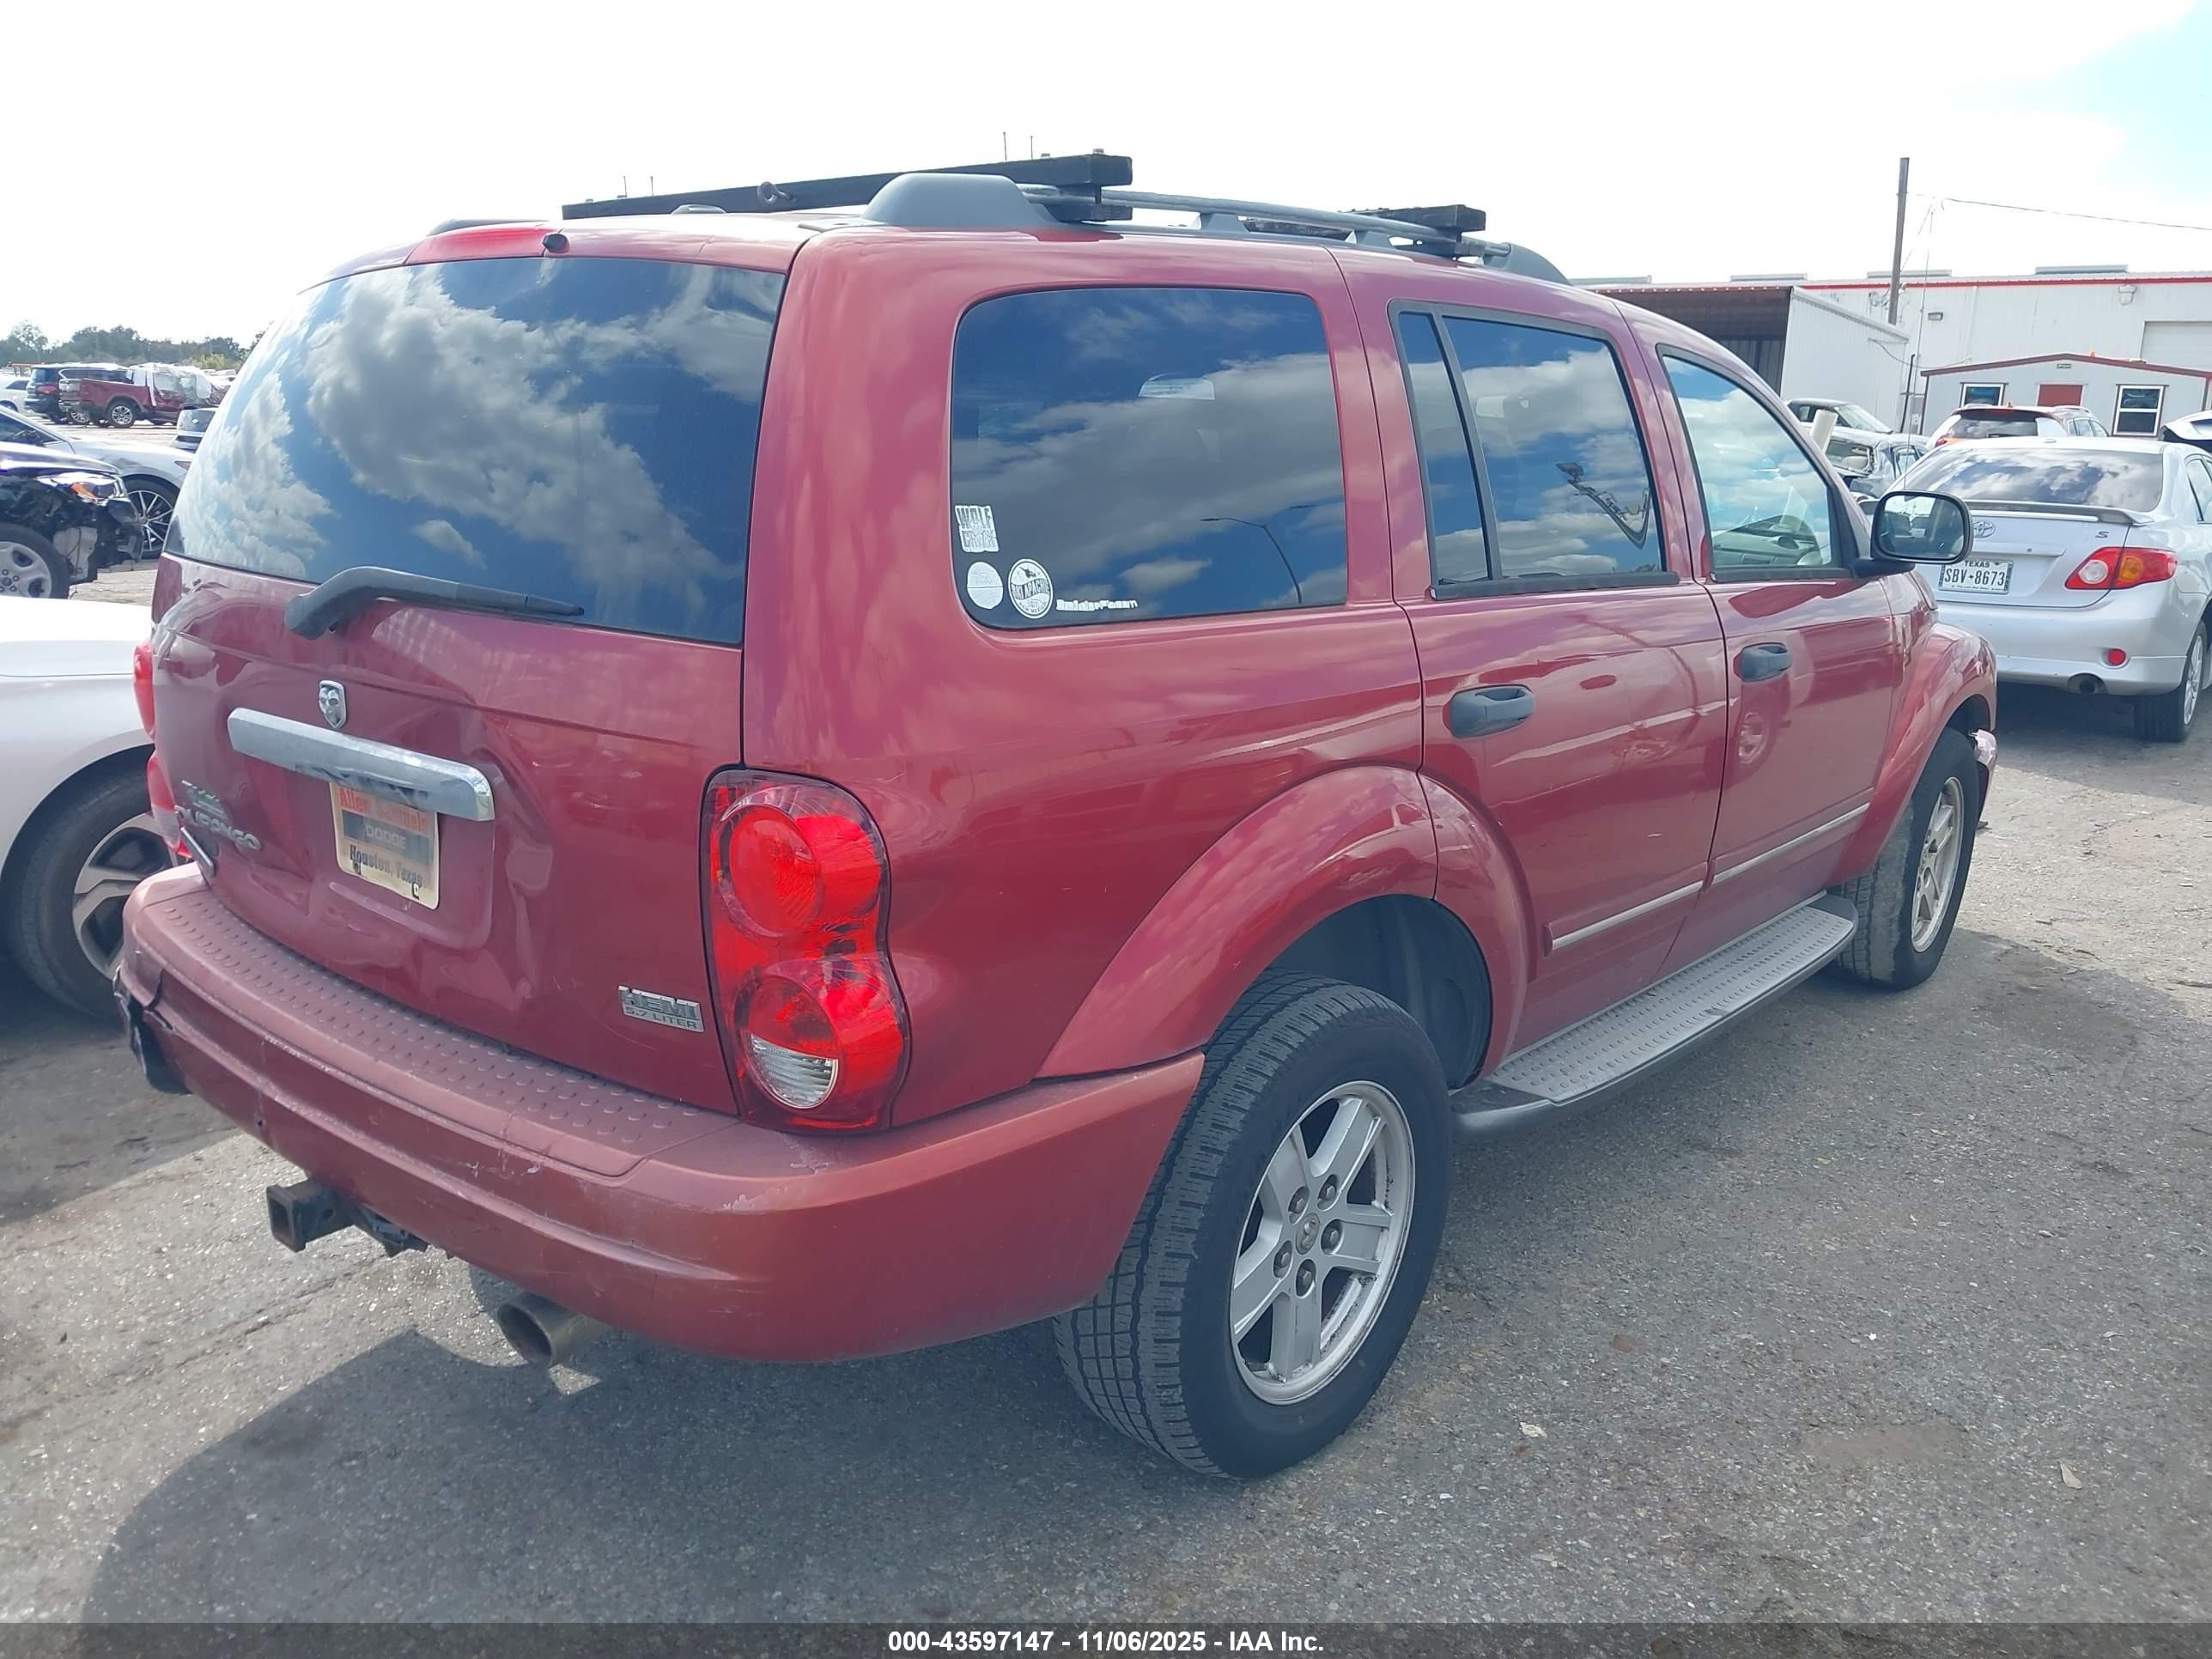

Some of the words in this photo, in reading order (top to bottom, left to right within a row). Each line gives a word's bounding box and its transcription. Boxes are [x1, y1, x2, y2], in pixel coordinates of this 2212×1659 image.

[2094, 530, 2110, 538] S
[1964, 560, 1990, 568] TEXAS
[365, 823, 407, 849] DODGE
[349, 844, 394, 878] Houston,
[618, 985, 701, 1019] HEMI
[625, 1006, 647, 1016] 5.7
[653, 1012, 698, 1030] LITER
